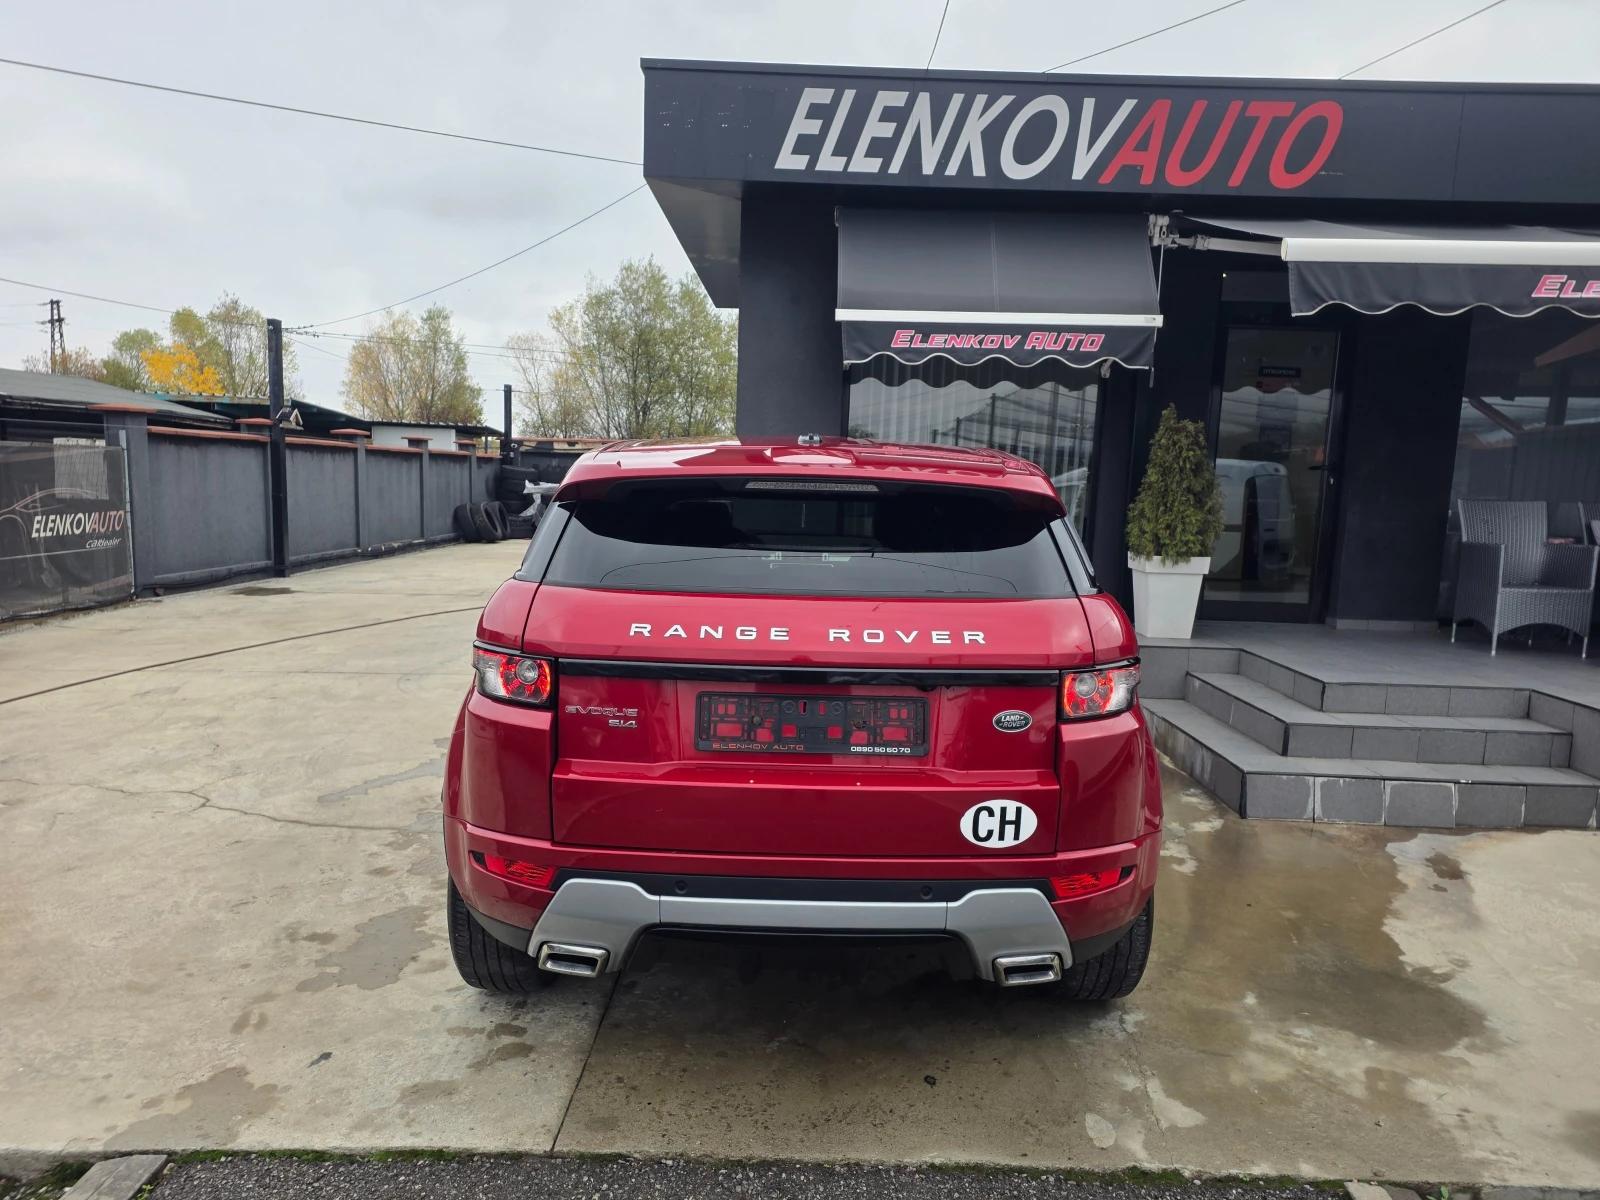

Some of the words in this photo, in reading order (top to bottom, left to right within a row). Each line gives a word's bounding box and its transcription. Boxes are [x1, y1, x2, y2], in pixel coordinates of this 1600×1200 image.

[774, 87, 1344, 190] ELENKOVAUTO
[891, 329, 1021, 349] ELENKOV
[1024, 331, 1105, 351] AUTO
[31, 509, 125, 538] ELENKOVAUTO
[629, 622, 790, 641] RANGE
[828, 628, 986, 644] ROVER
[565, 705, 639, 717] EVOQUE
[1001, 714, 1020, 722] LAND
[1003, 720, 1026, 728] ROVER
[712, 742, 768, 750] ELENKOV
[971, 805, 1023, 842] CH
